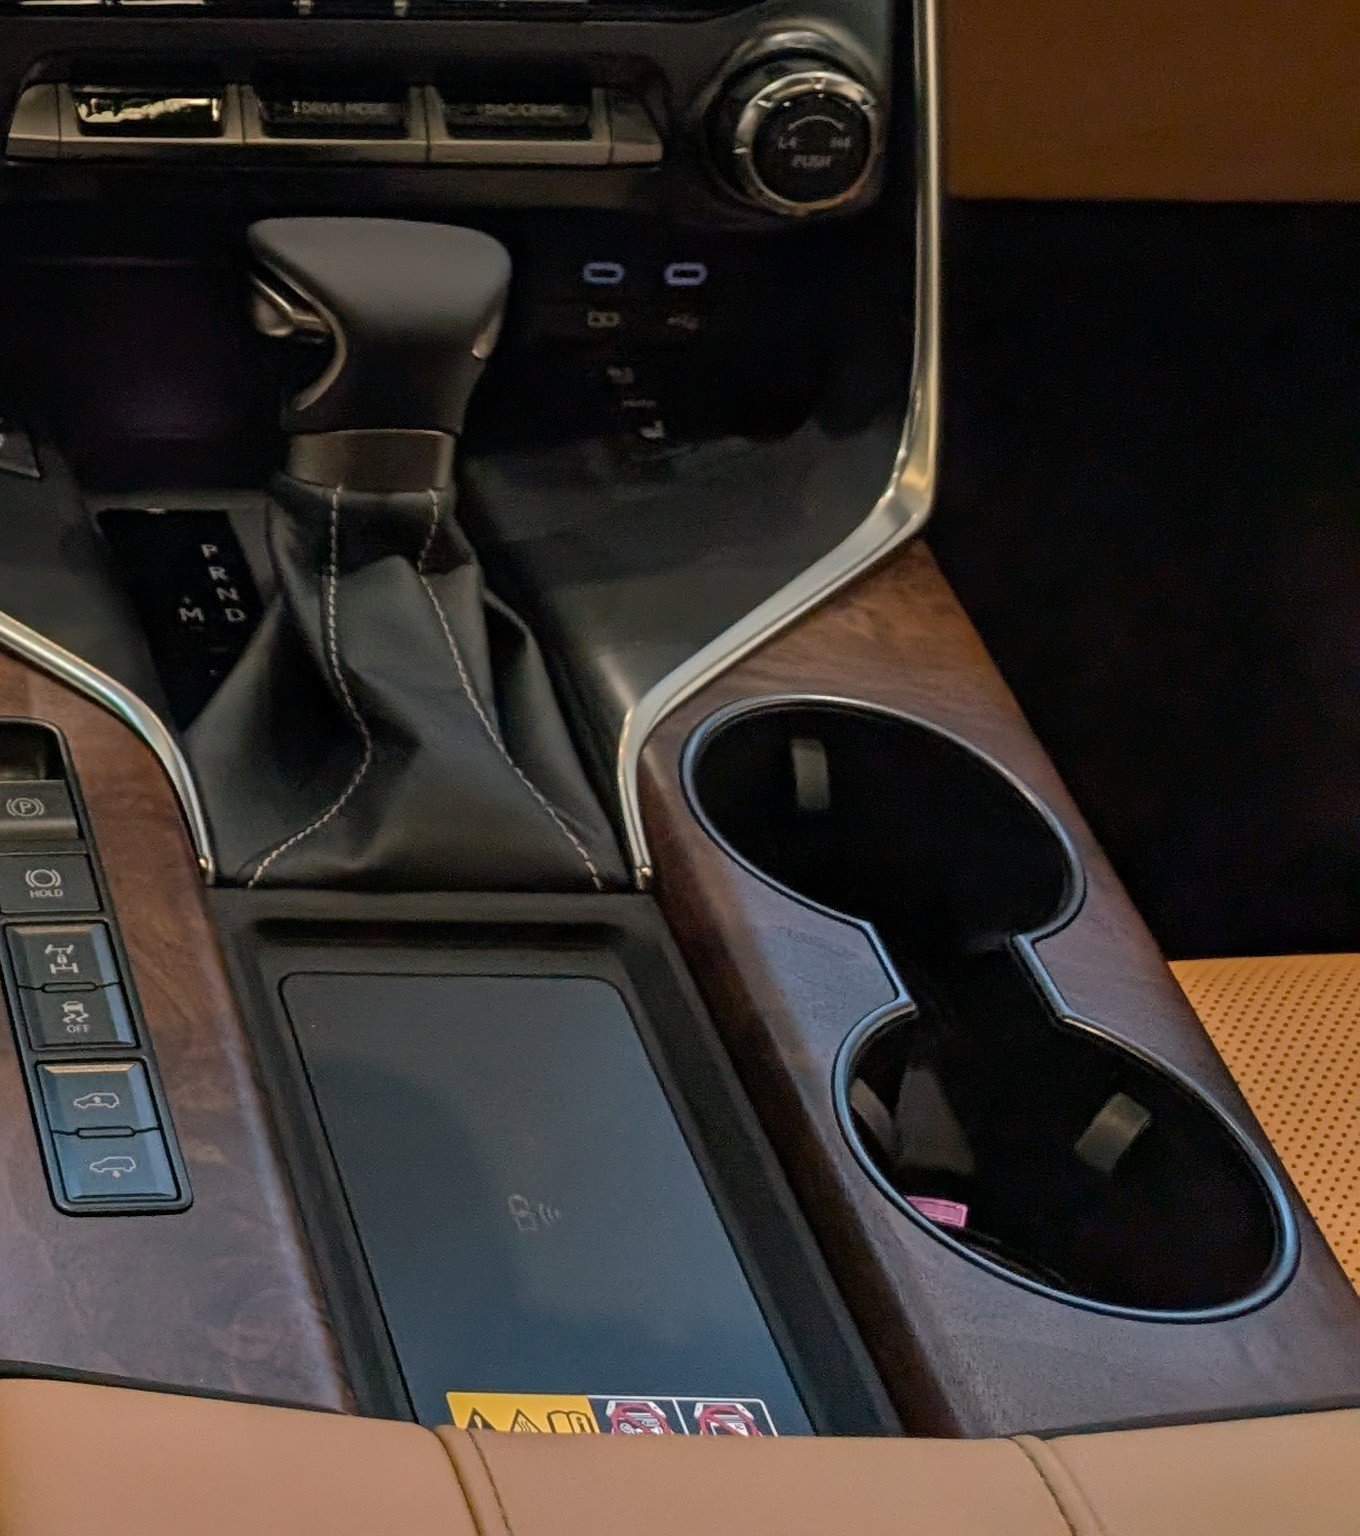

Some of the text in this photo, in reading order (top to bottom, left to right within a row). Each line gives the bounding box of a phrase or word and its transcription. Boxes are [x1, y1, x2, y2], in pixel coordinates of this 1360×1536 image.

[201, 544, 219, 558] P
[208, 566, 228, 581] R
[217, 587, 239, 601] N
[179, 607, 205, 623] M
[225, 608, 246, 623] D
[30, 889, 64, 898] HOLD
[66, 1024, 89, 1034] OFF
